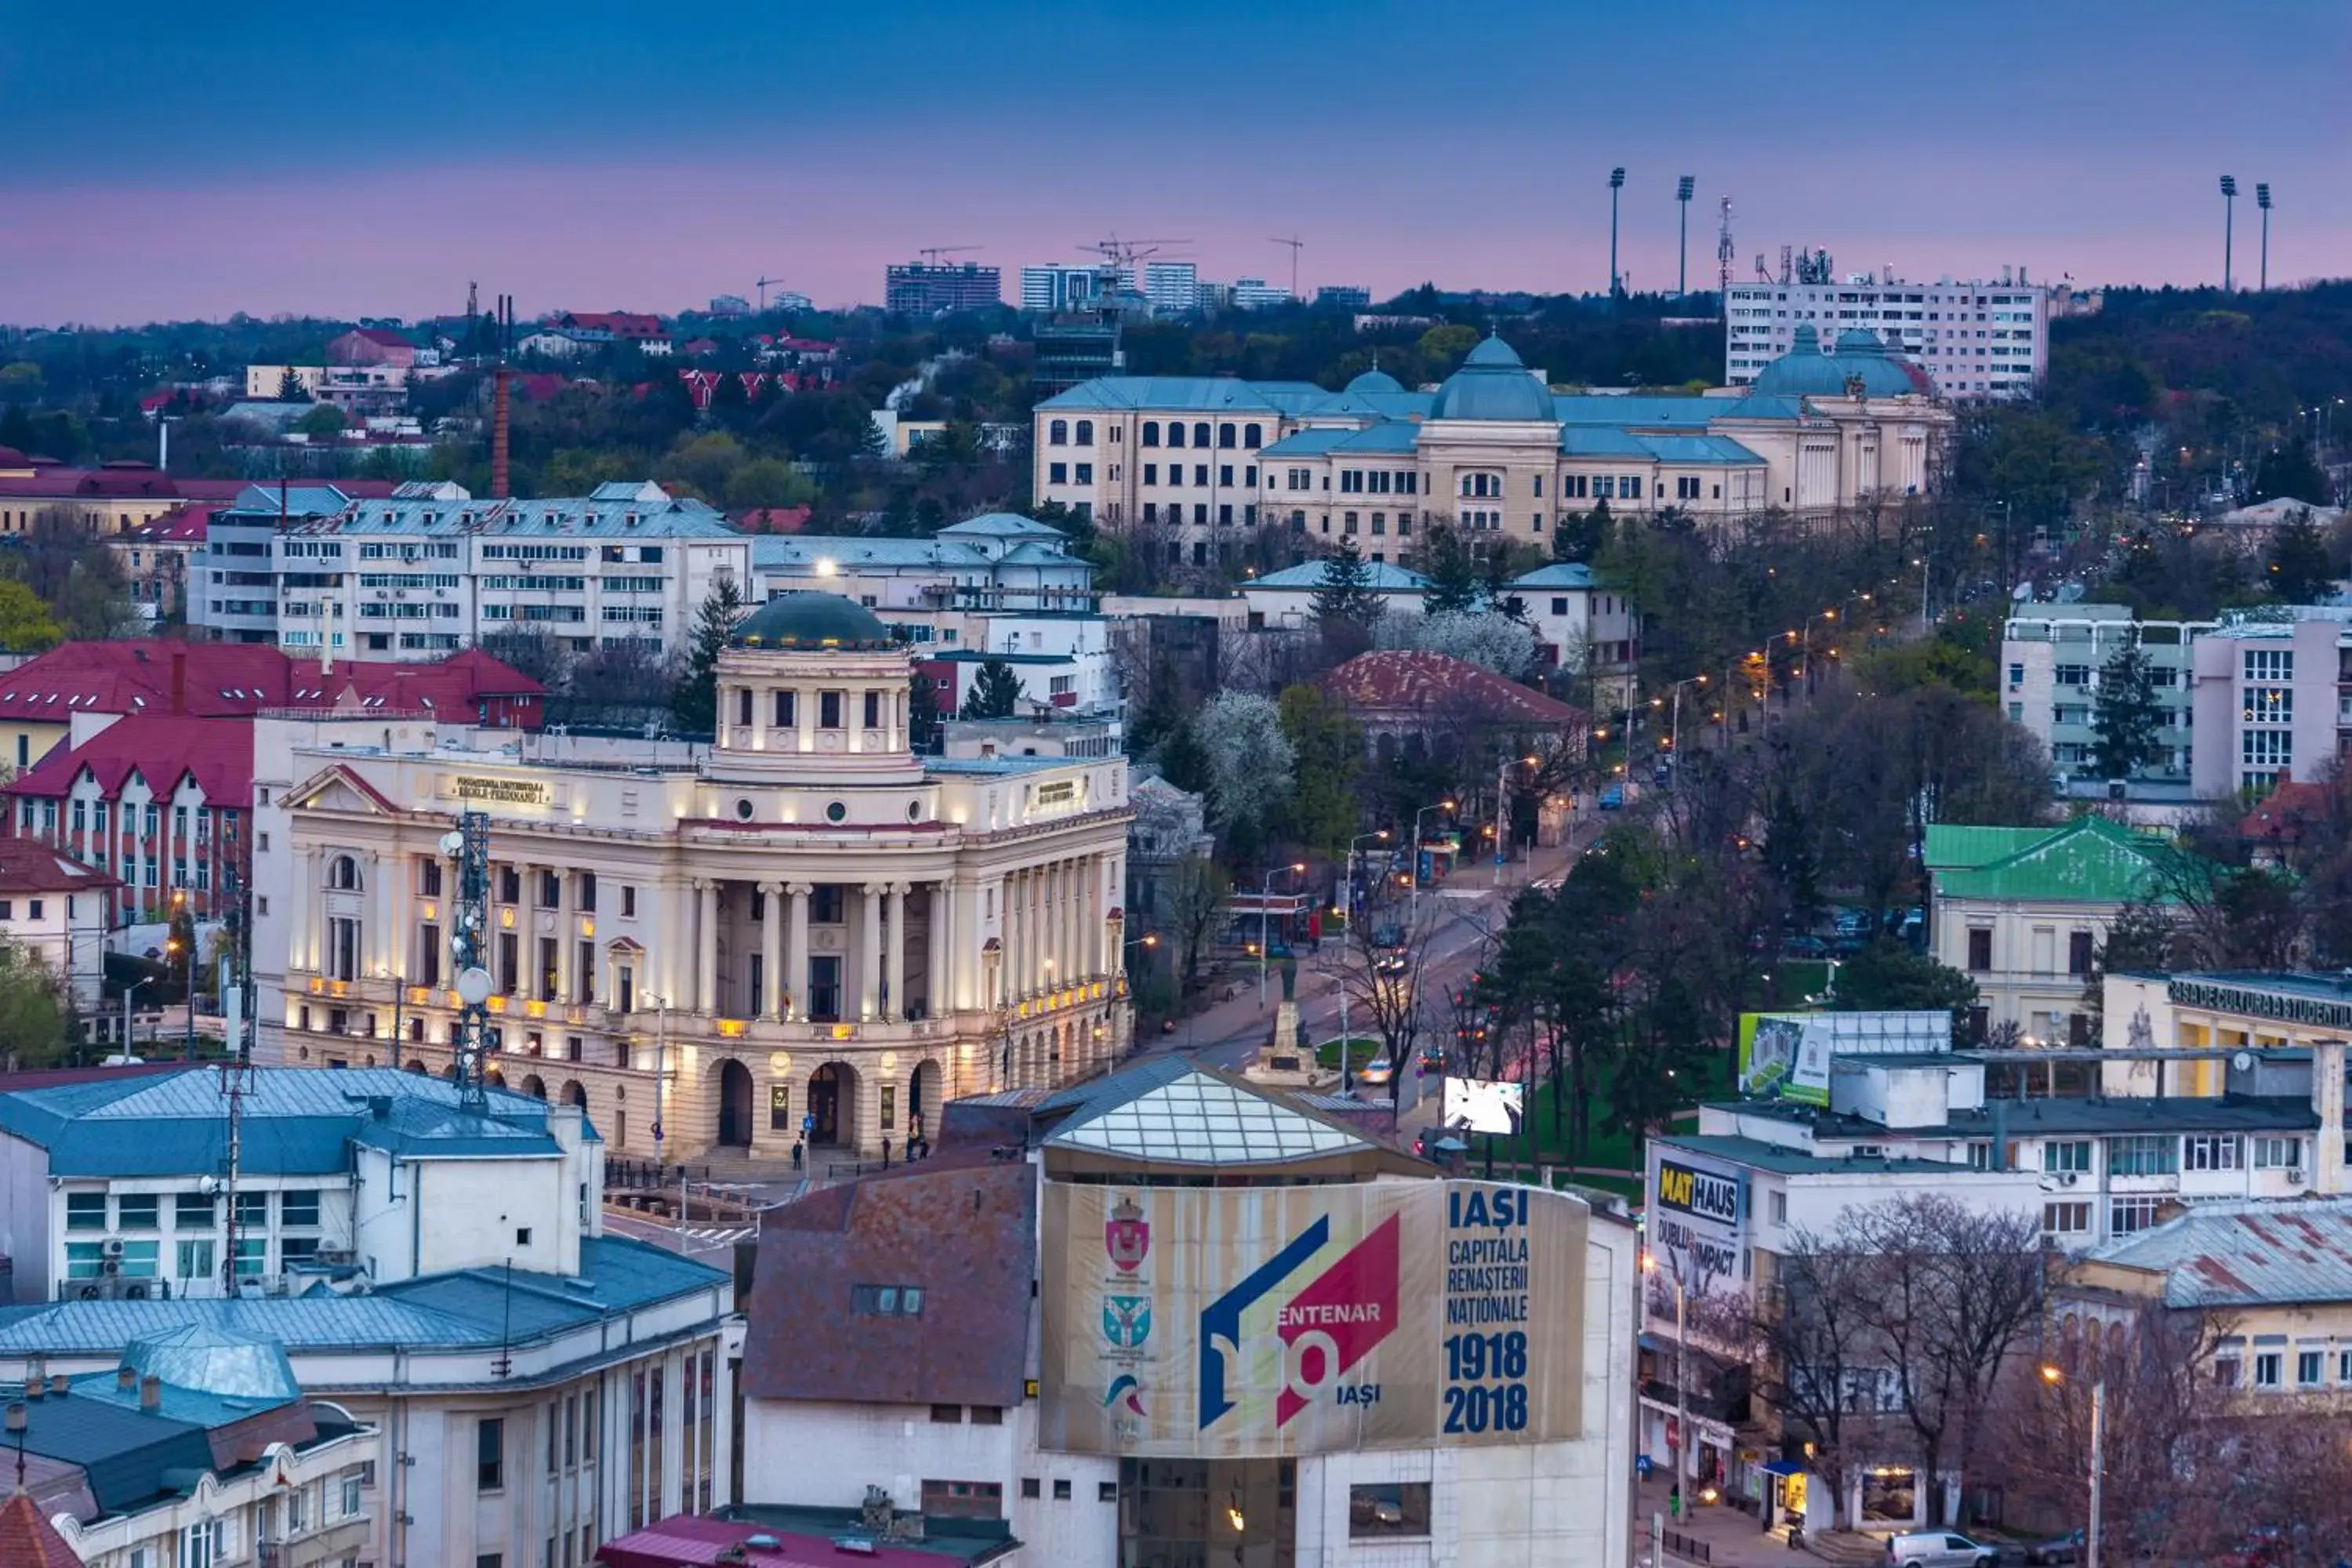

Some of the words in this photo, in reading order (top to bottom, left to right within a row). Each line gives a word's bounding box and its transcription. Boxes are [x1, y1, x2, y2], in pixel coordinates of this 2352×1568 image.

[2168, 980, 2201, 1005] CASA
[2200, 985, 2218, 1007] DE
[1450, 1238, 1529, 1265] CAPITALA
[1443, 1331, 1527, 1381] 1918
[1443, 1384, 1528, 1433] 2018
